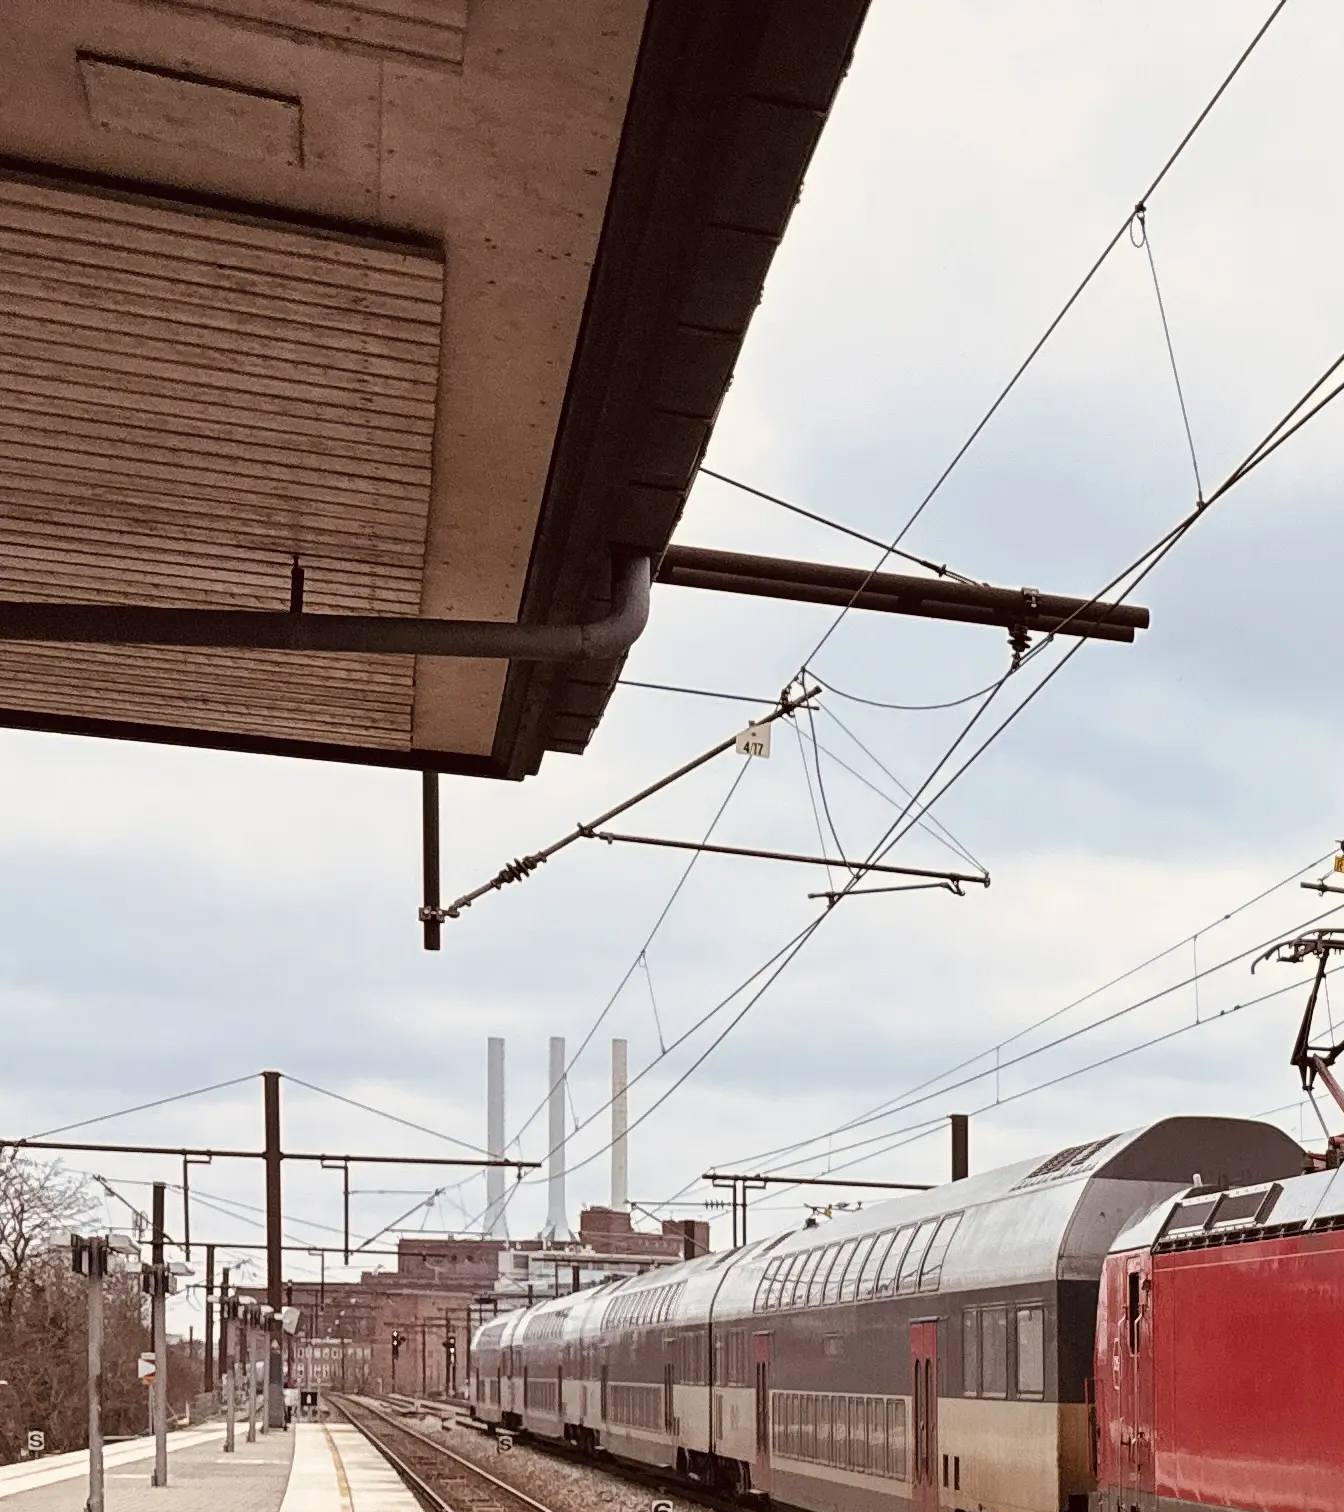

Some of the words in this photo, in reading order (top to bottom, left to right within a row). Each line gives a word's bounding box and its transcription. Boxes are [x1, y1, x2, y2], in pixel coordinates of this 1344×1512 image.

[743, 741, 764, 756] 4/17
[30, 1434, 43, 1447] S
[500, 1438, 511, 1451] S
